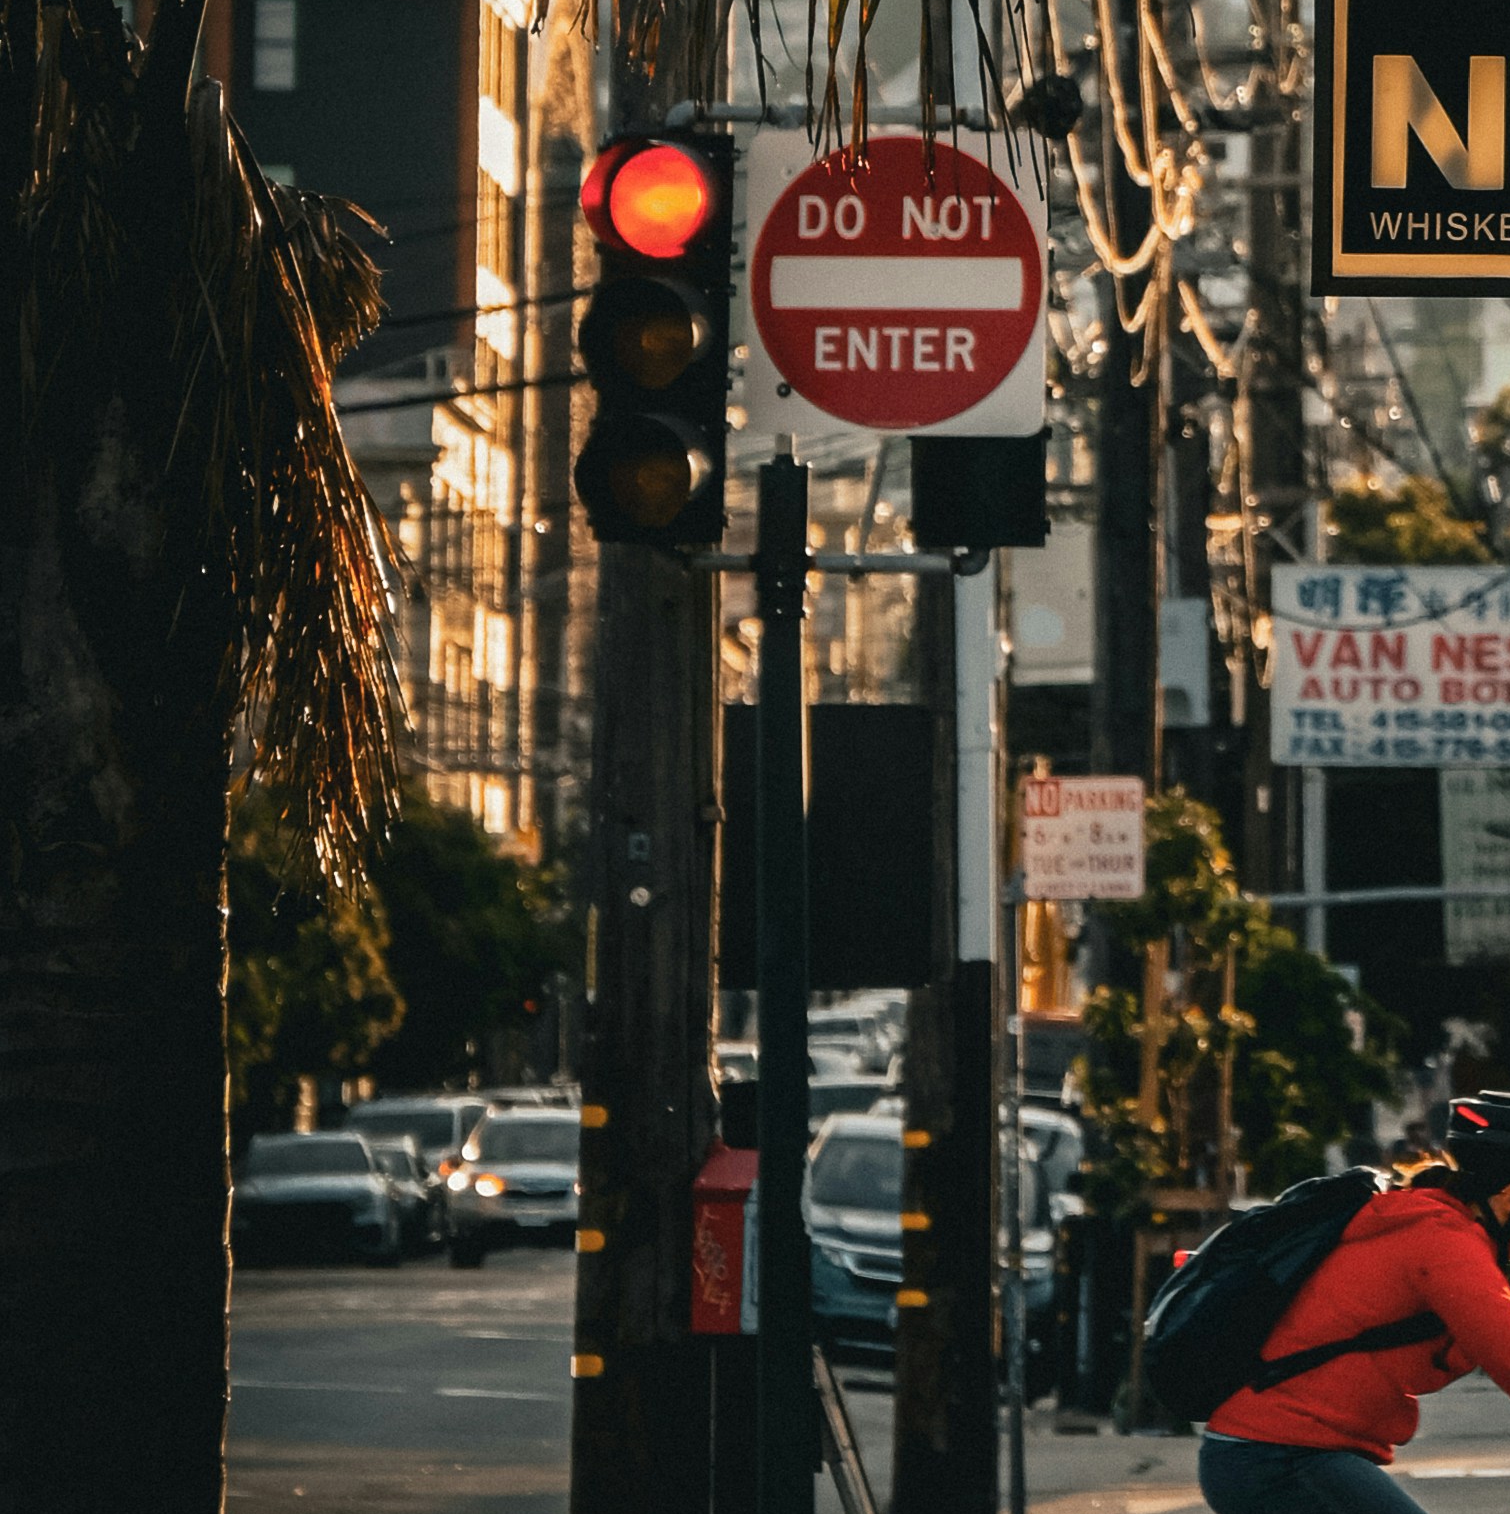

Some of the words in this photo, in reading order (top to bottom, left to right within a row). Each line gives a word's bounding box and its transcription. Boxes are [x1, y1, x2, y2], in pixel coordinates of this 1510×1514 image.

[798, 193, 866, 240] DO
[902, 194, 1000, 241] NOT
[814, 325, 976, 372] ENTER
[1292, 631, 1406, 670] VAN
[1300, 676, 1420, 703] AUTO
